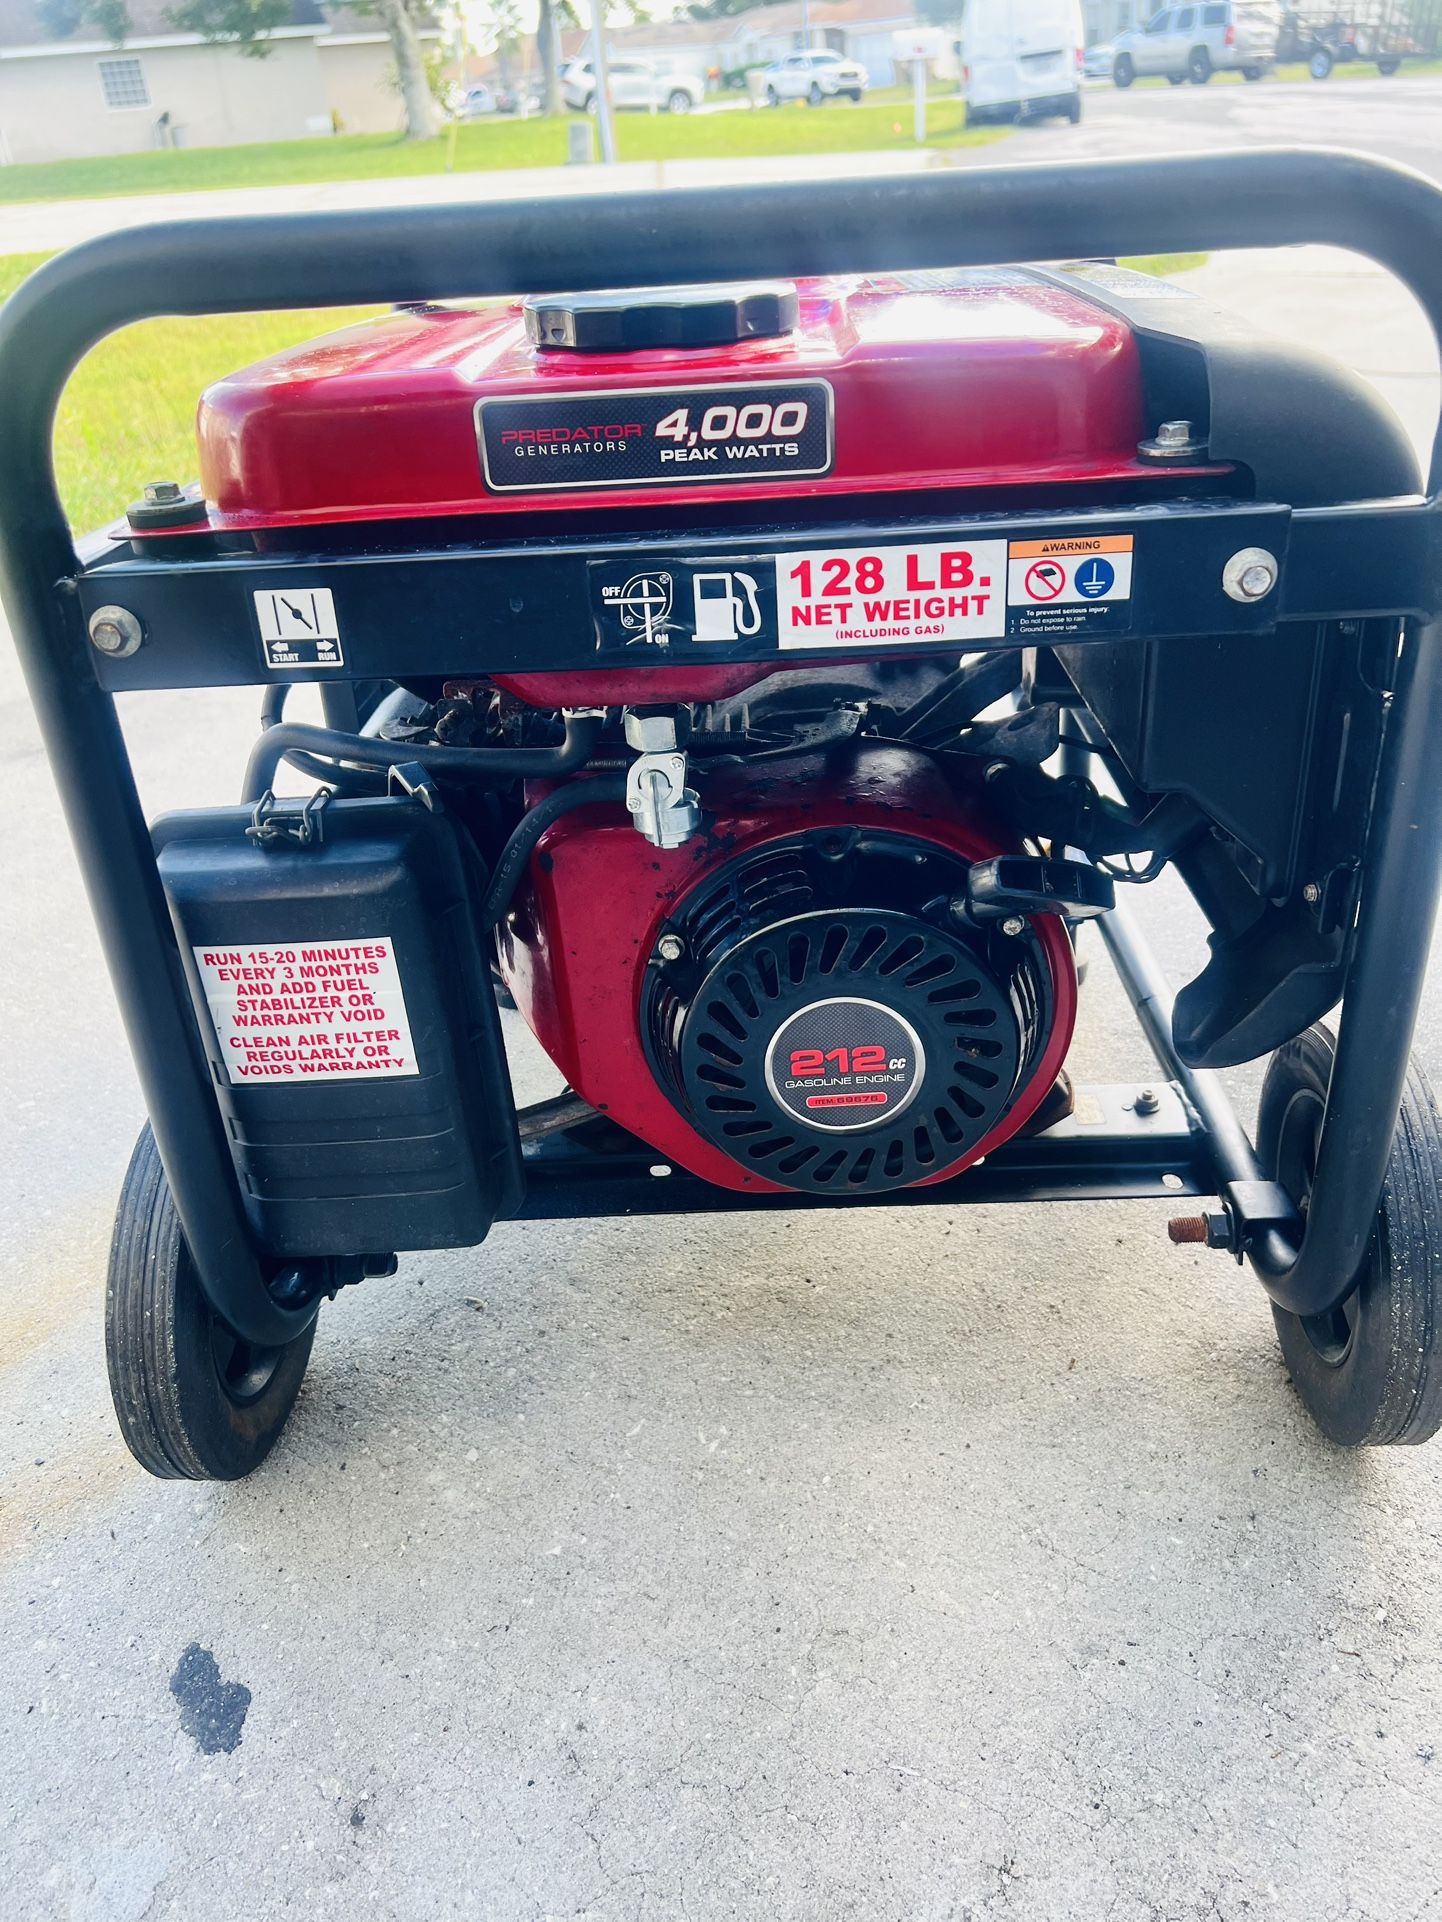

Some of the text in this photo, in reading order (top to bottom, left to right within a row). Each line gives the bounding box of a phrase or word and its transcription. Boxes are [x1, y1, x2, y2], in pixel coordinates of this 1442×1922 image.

[655, 402, 808, 447] 4,000
[501, 423, 642, 445] PREDATOR
[514, 440, 627, 457] GENERATORS
[660, 443, 799, 462] PEAK WATTS
[1050, 540, 1101, 552] WARNING
[790, 551, 990, 598] 128 LB.
[602, 586, 621, 597] OFF
[792, 594, 990, 627] NET WEIGHT
[1036, 608, 1061, 617] prevent
[1042, 617, 1065, 625] expose
[655, 633, 669, 644] ON
[835, 623, 945, 640] (INCLUDING GAS)
[272, 653, 299, 662] START
[317, 652, 337, 661] RUN
[203, 945, 387, 966] RUN 15-20 MINUTES
[218, 962, 379, 981] EVERY 3 MONTHS
[236, 978, 370, 996] AND ADD FUEL
[237, 993, 375, 1012] STABILIZER OR
[232, 1008, 385, 1027] WARRANTY VOID
[229, 1029, 400, 1049] CLEAN AIR FILTER
[246, 1045, 390, 1062] REGULARLY OR
[789, 1045, 887, 1076] 212
[237, 1058, 405, 1076] VOIDS WARRANTY
[785, 1073, 905, 1088] GASOLINE ENGINE
